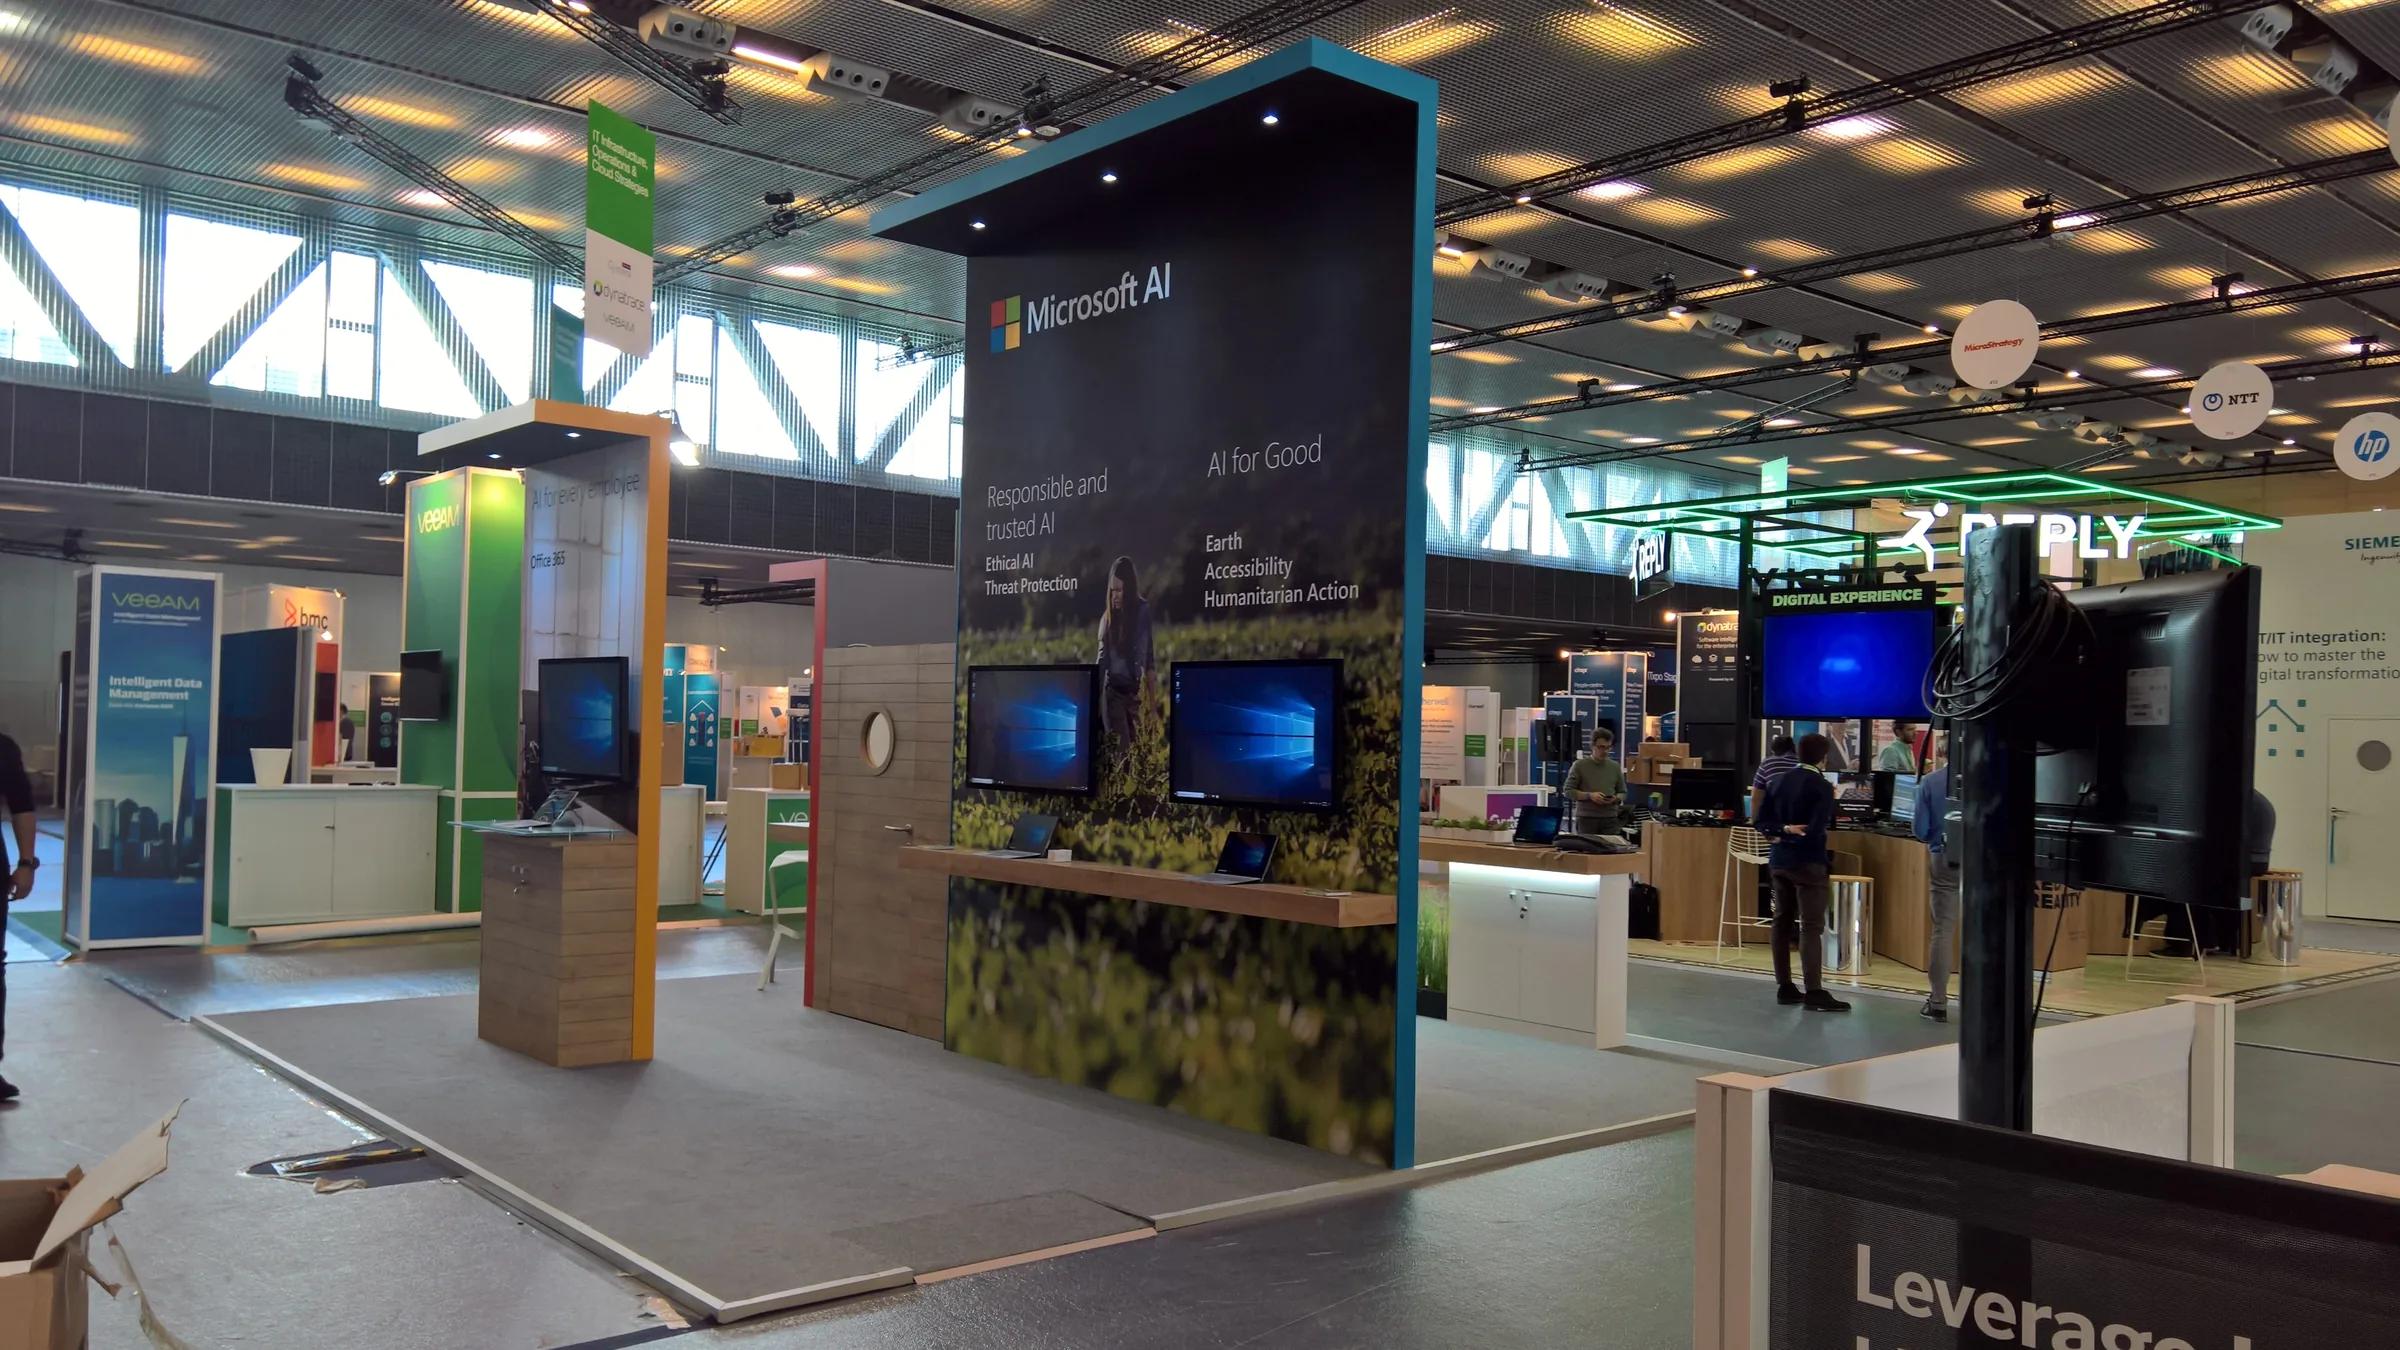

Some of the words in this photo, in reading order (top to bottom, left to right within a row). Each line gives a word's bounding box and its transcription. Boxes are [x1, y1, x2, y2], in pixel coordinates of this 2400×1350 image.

[592, 129, 600, 143] IT
[592, 144, 630, 174] Operations
[631, 165, 637, 177] &
[592, 158, 614, 180] Cloud
[614, 170, 649, 198] Strategies
[603, 285, 645, 312] dynatrace
[1026, 271, 1138, 335] Microsoft
[1143, 262, 1172, 304] AI
[1963, 338, 2024, 353] MicroStrategy
[2228, 392, 2260, 406] NTT
[1207, 450, 1226, 478] AI
[1232, 446, 1260, 475] for
[1265, 433, 1322, 469] Good
[2358, 431, 2387, 463] hp
[532, 489, 542, 511] AI
[588, 473, 641, 501] employee
[988, 473, 1074, 512] Responsible
[1078, 467, 1108, 496] and
[986, 513, 1036, 541] trusted
[1039, 511, 1055, 536] AI
[1960, 513, 2147, 560] PLY
[1206, 531, 1242, 553] Earth
[2344, 535, 2400, 551] SIEME
[530, 552, 551, 570] Office
[552, 550, 565, 567] 365
[985, 553, 1020, 572] Ethical
[1022, 553, 1034, 569] AI
[1638, 530, 1666, 582] REPLY
[1204, 556, 1293, 580] Accessibility
[985, 579, 1018, 596] Threat
[1020, 574, 1078, 594] Protection
[1204, 585, 1303, 608] Humanitarian
[1306, 580, 1360, 602] Action
[1772, 593, 1827, 607] DIGITAL
[1830, 588, 1923, 604] EXPERIENCE
[300, 606, 328, 630] bmc
[2290, 629, 2386, 646] integration:
[2284, 651, 2299, 662] to
[2303, 651, 2356, 662] master
[2360, 648, 2386, 661] the
[109, 675, 172, 689] Intelligent
[174, 678, 202, 689] Data
[2295, 666, 2400, 681] transformatio
[109, 688, 189, 700] Management
